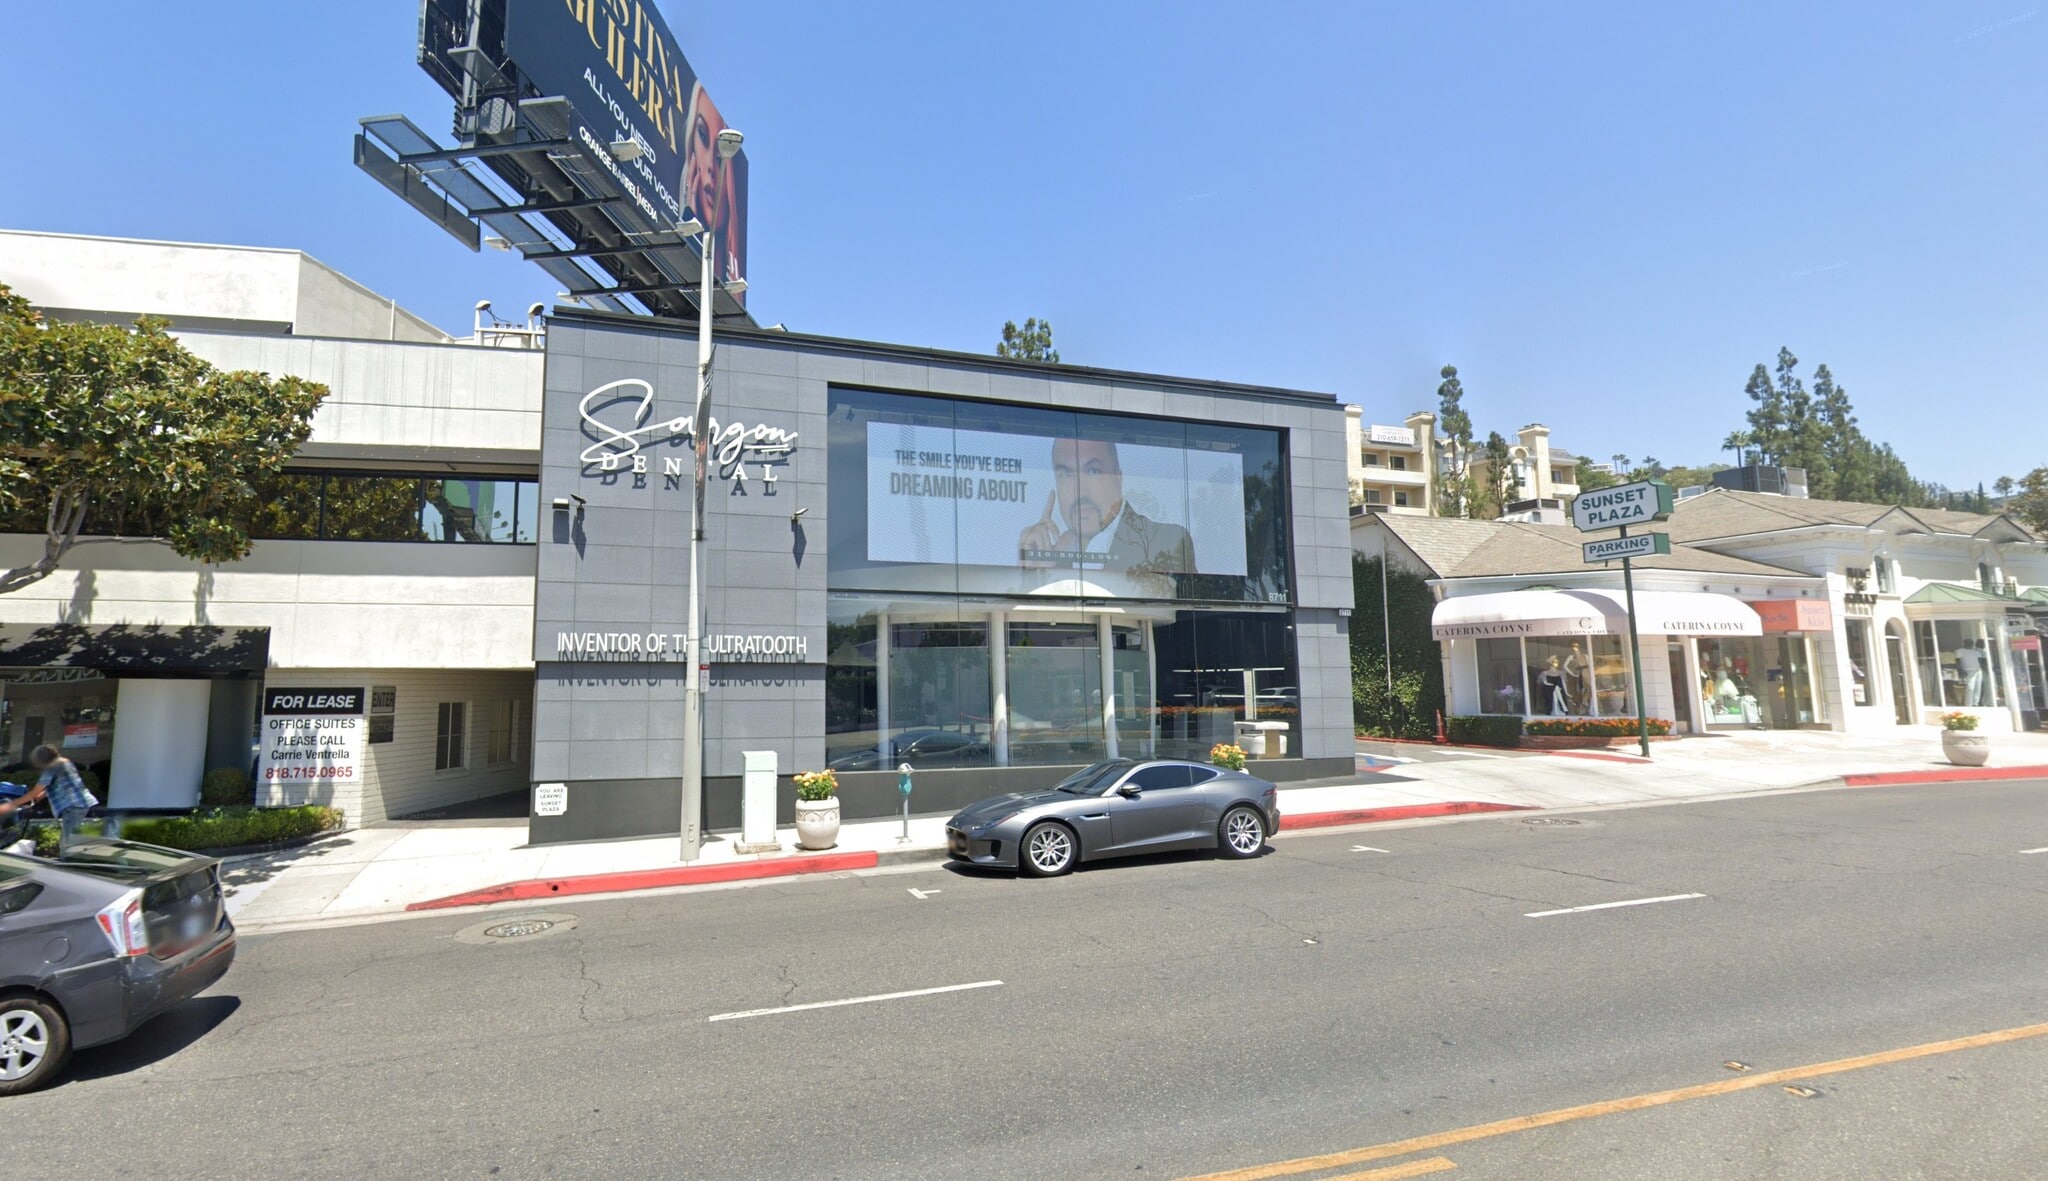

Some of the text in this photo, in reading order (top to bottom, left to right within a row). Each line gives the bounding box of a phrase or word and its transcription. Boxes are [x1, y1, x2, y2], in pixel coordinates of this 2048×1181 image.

[605, 0, 683, 114] STINA
[583, 67, 657, 165] ALL YOU NEED
[579, 126, 612, 171] ORANGE
[632, 156, 653, 186] OUR
[653, 175, 680, 217] VOICE
[600, 452, 778, 482] DENAL
[894, 449, 1022, 474] THE SMILE YOU'VE BEEN
[890, 472, 1028, 503] DREAMING ABOUT
[1581, 487, 1647, 511] SUNSET
[1588, 504, 1645, 525] PLAZA
[1588, 537, 1650, 554] PARKING
[1435, 623, 1534, 637] CATERINA COYNE
[1578, 616, 1593, 630] C
[1663, 621, 1745, 631] CATERINA COYNE
[557, 632, 807, 655] INVENTOR OF TH ULTRATOOTH
[272, 695, 356, 709] FOR LEASE
[269, 718, 356, 730] OFFICE SUITES
[277, 735, 346, 747] PLEASE CALL
[271, 750, 350, 761] Carrie Ventrella
[265, 766, 353, 779] 818.715.0965
